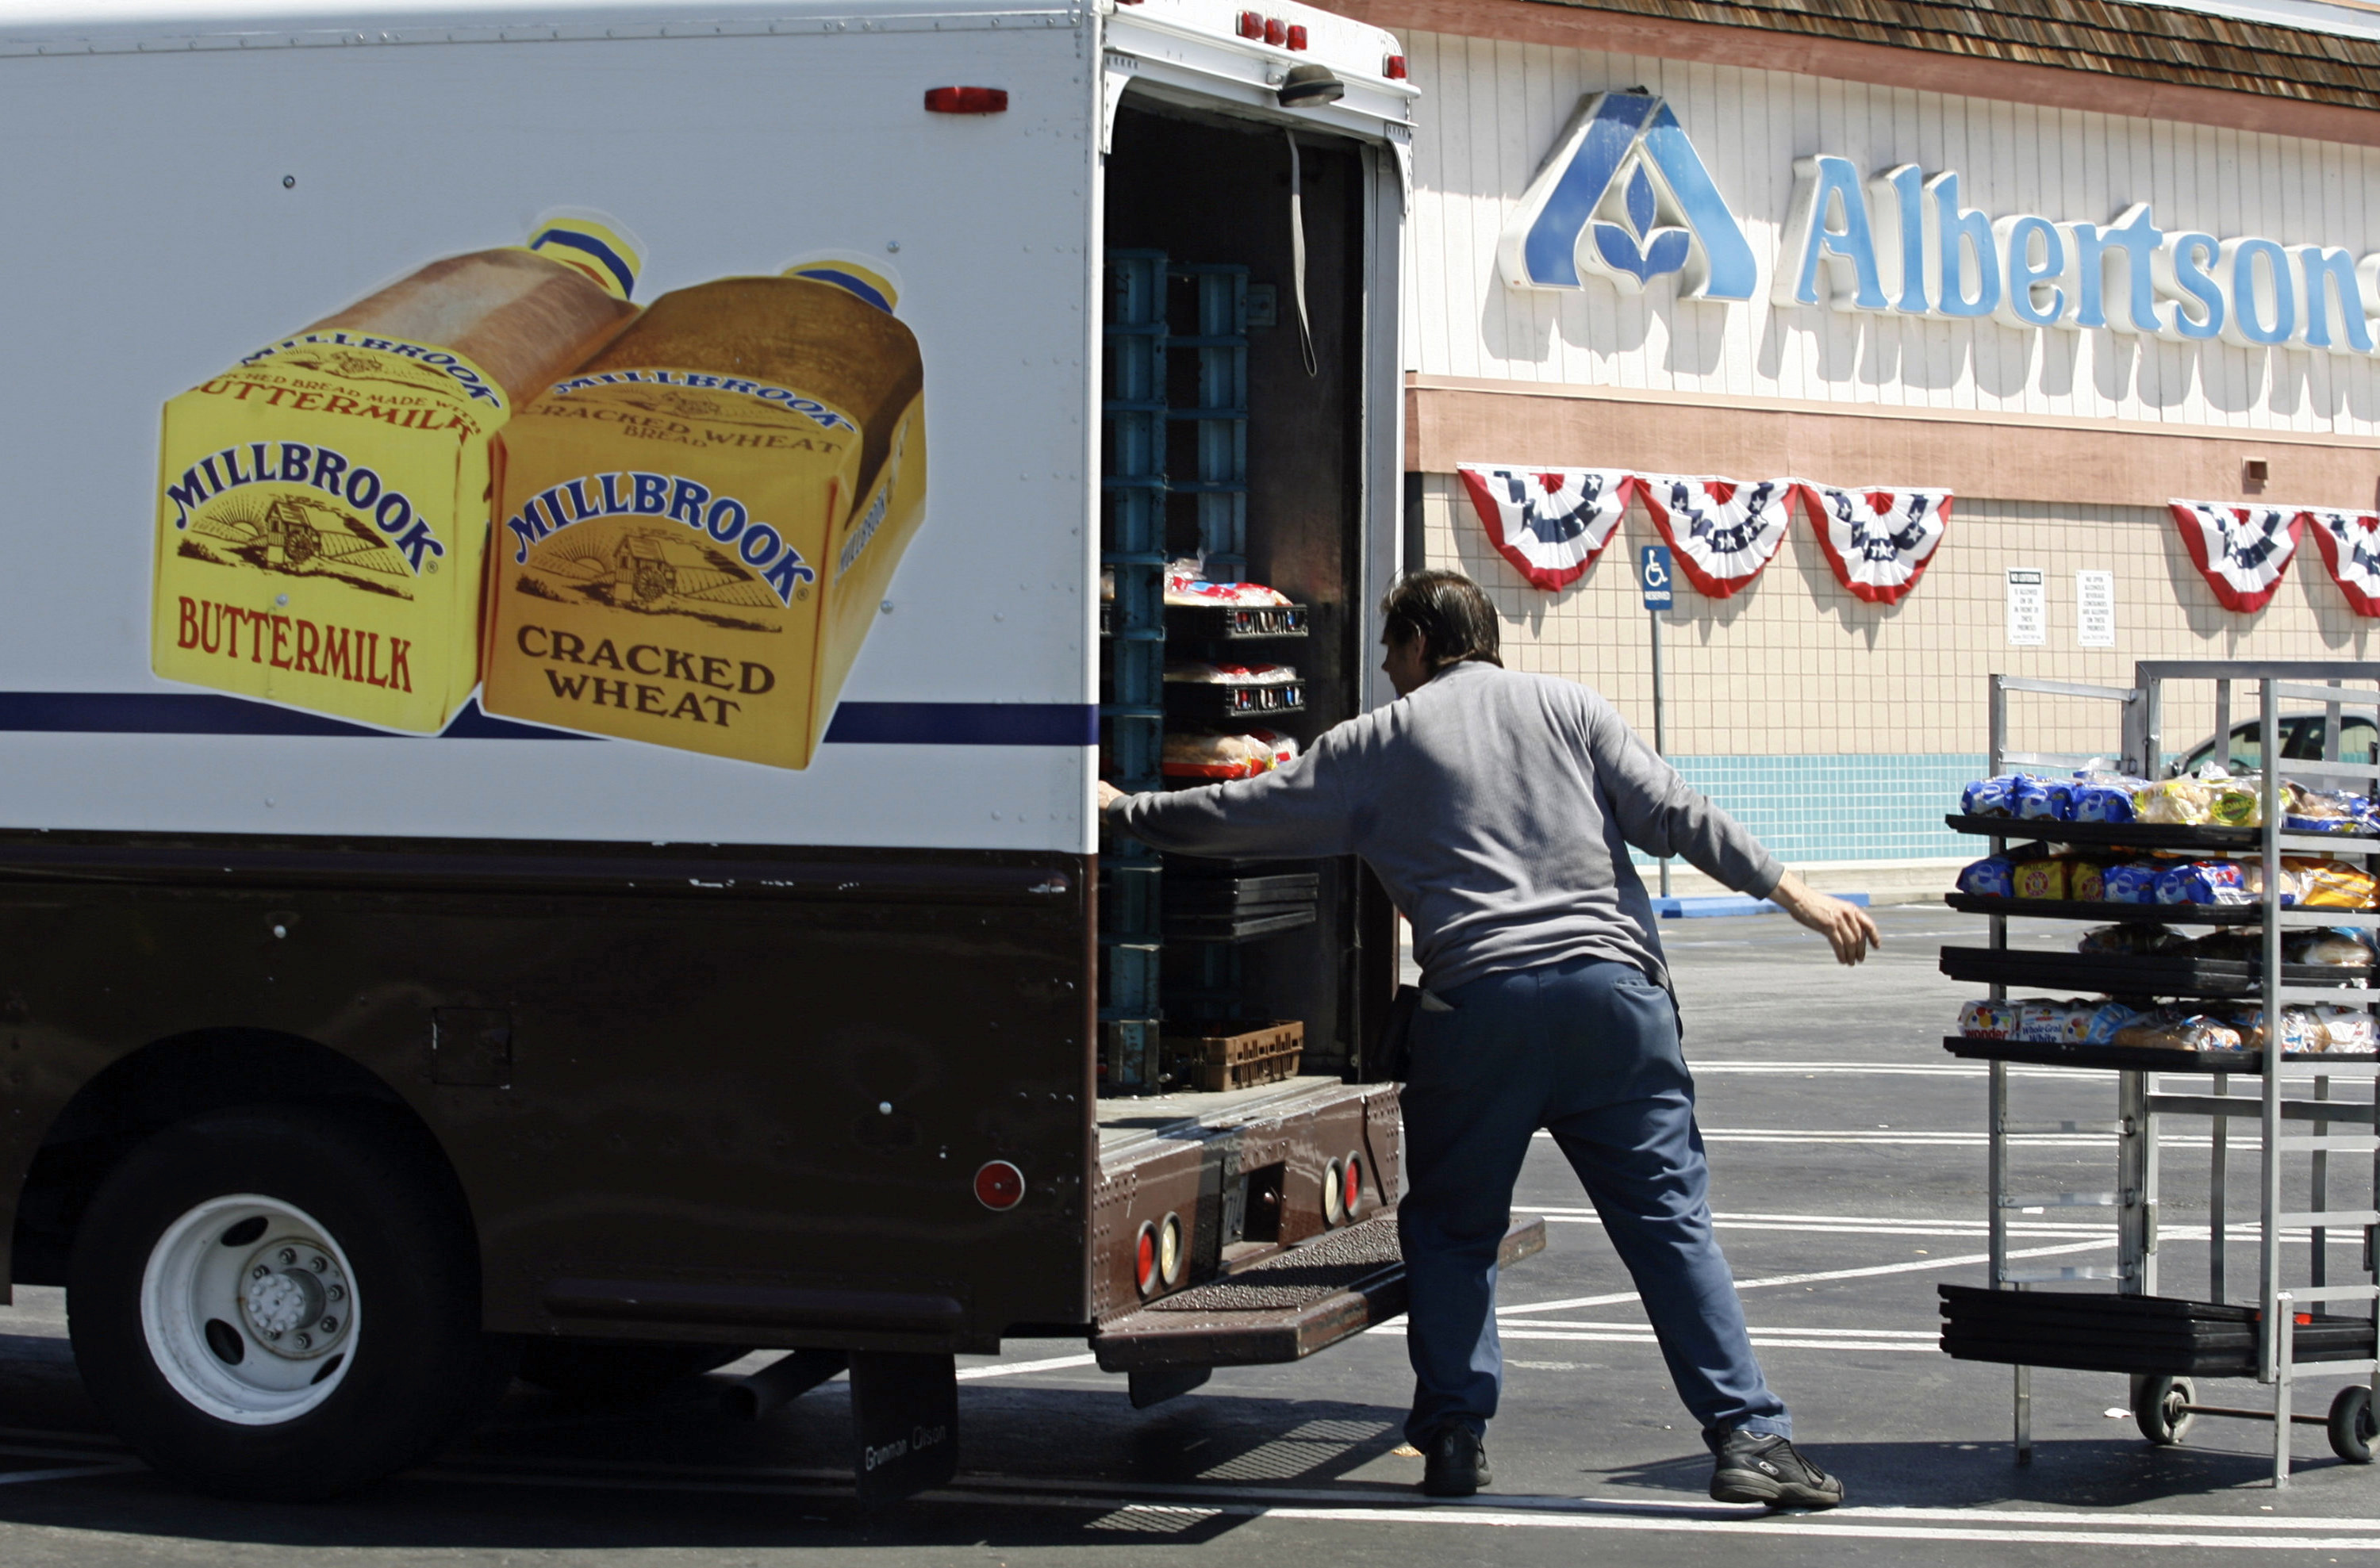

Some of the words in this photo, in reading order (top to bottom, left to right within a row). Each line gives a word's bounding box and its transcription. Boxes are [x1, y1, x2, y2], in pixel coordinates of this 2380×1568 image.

[1781, 155, 2380, 354] Albertson
[240, 332, 501, 410] MILLBROOK
[292, 379, 362, 397] BREAD
[366, 394, 428, 405] MADE
[553, 370, 858, 434] MILLBROOK
[187, 379, 474, 447] UTTERMILK
[623, 426, 708, 448] BREAD
[702, 429, 843, 454] WHEAT
[165, 442, 445, 577] MILLBROOK
[506, 472, 816, 608] MILLBROOK
[177, 596, 413, 694] BUTTERMILK
[516, 624, 775, 696] CRACKED
[544, 669, 741, 727] WHEAT
[1964, 1028, 2010, 1041] wonder
